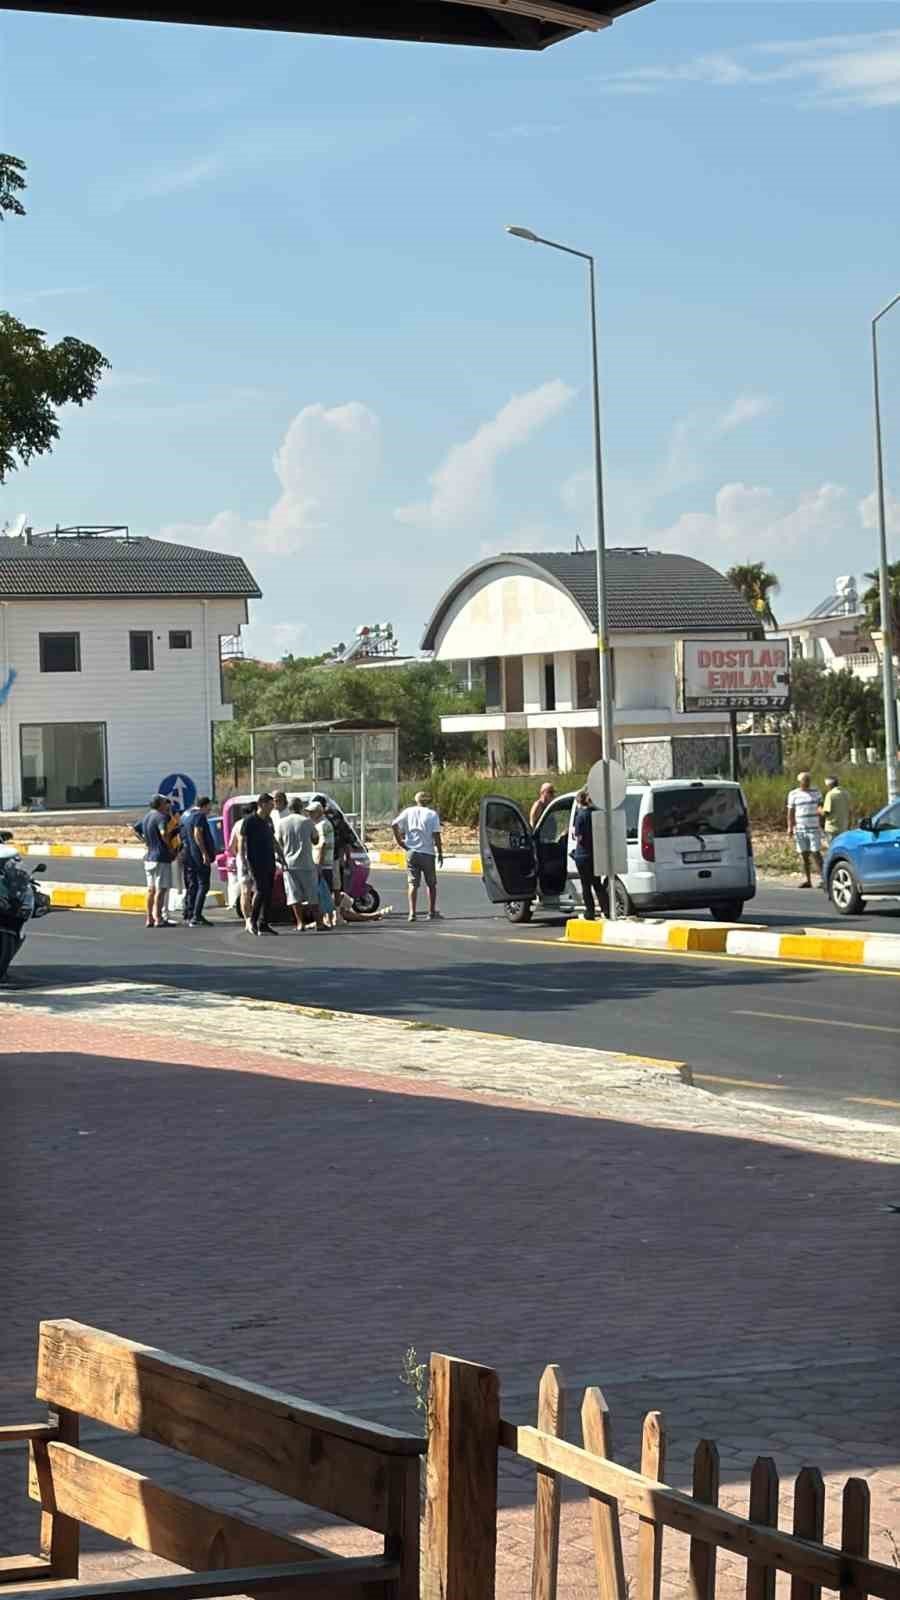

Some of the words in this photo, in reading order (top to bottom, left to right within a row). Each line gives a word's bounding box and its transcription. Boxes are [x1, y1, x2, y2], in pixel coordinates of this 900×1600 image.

[697, 648, 785, 668] DOSTLAR
[708, 671, 776, 688] EMLAK
[770, 696, 785, 705] 77
